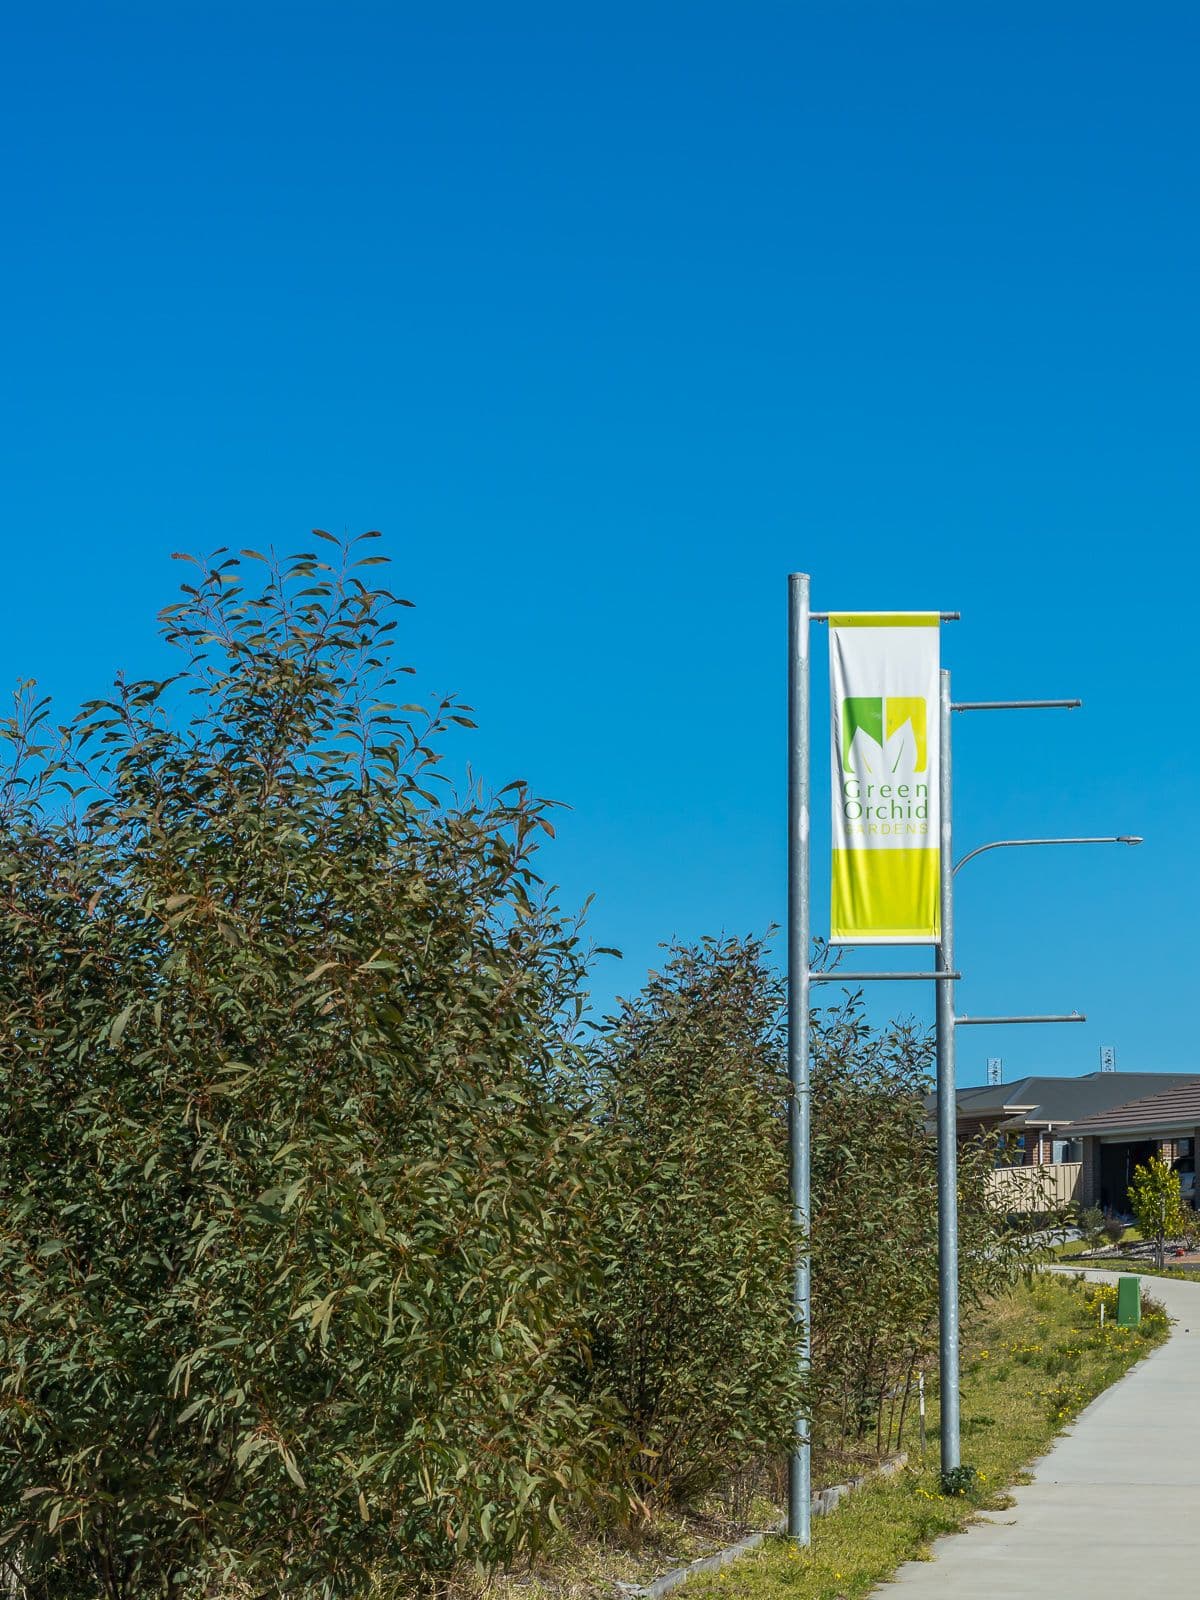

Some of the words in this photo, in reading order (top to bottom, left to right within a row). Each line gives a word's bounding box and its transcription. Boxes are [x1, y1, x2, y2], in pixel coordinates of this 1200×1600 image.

[844, 780, 928, 798] Green
[844, 799, 928, 820] Orchid
[846, 823, 928, 835] GARDENS
